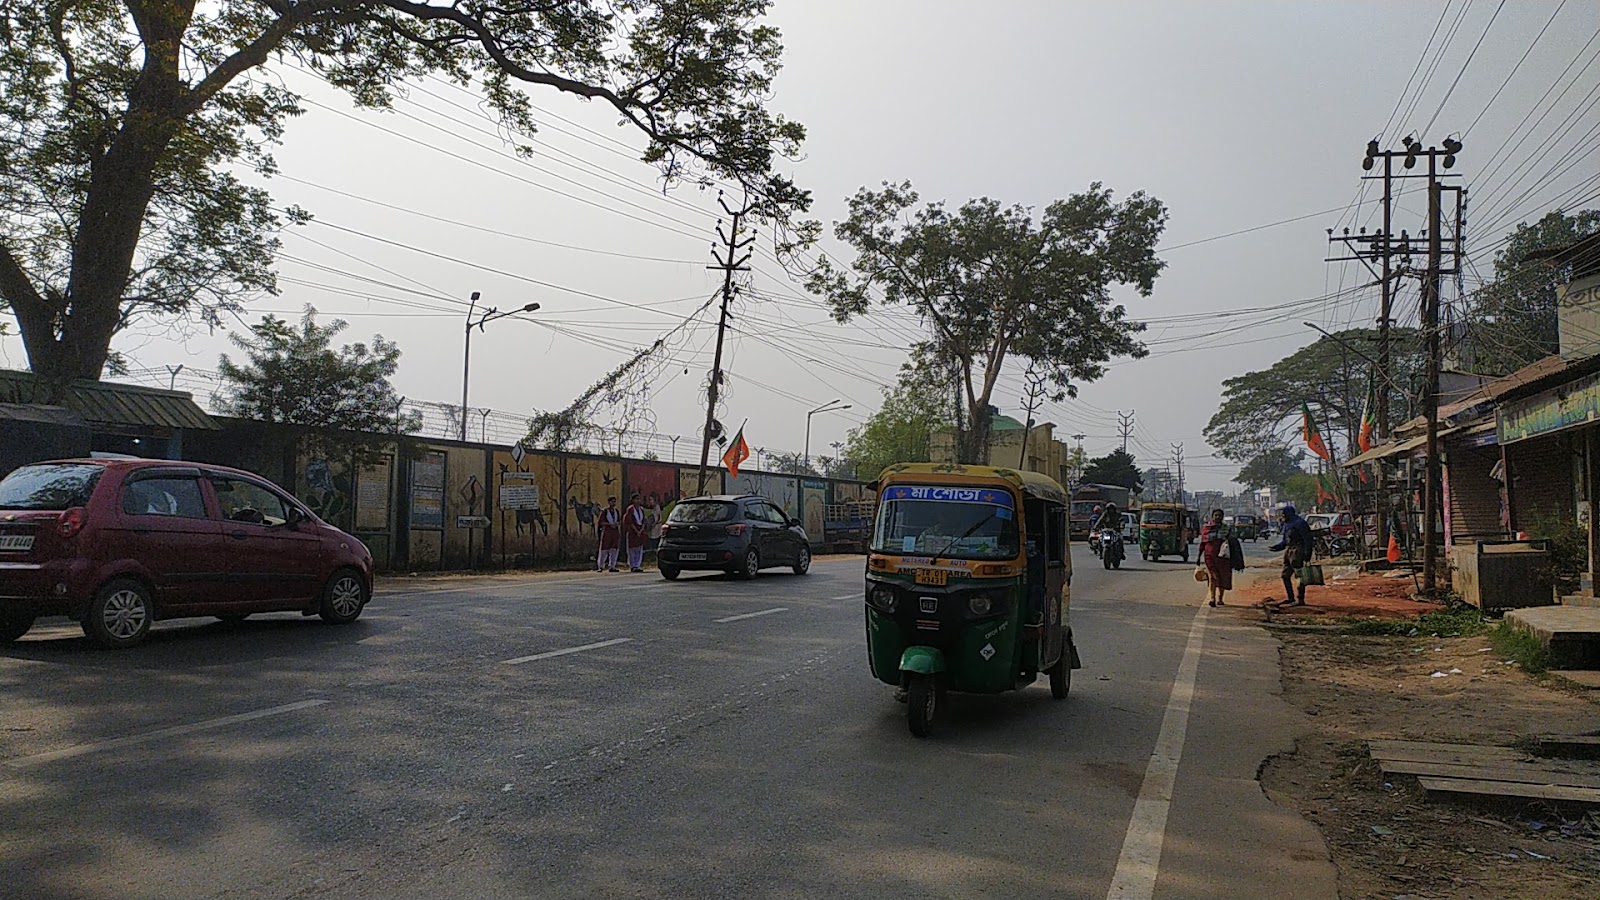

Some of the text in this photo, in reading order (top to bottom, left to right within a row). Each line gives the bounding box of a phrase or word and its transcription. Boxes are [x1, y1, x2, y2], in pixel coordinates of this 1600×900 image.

[911, 487, 981, 501] মা শোভা
[948, 569, 973, 579] AREA
[922, 602, 934, 610] RE
